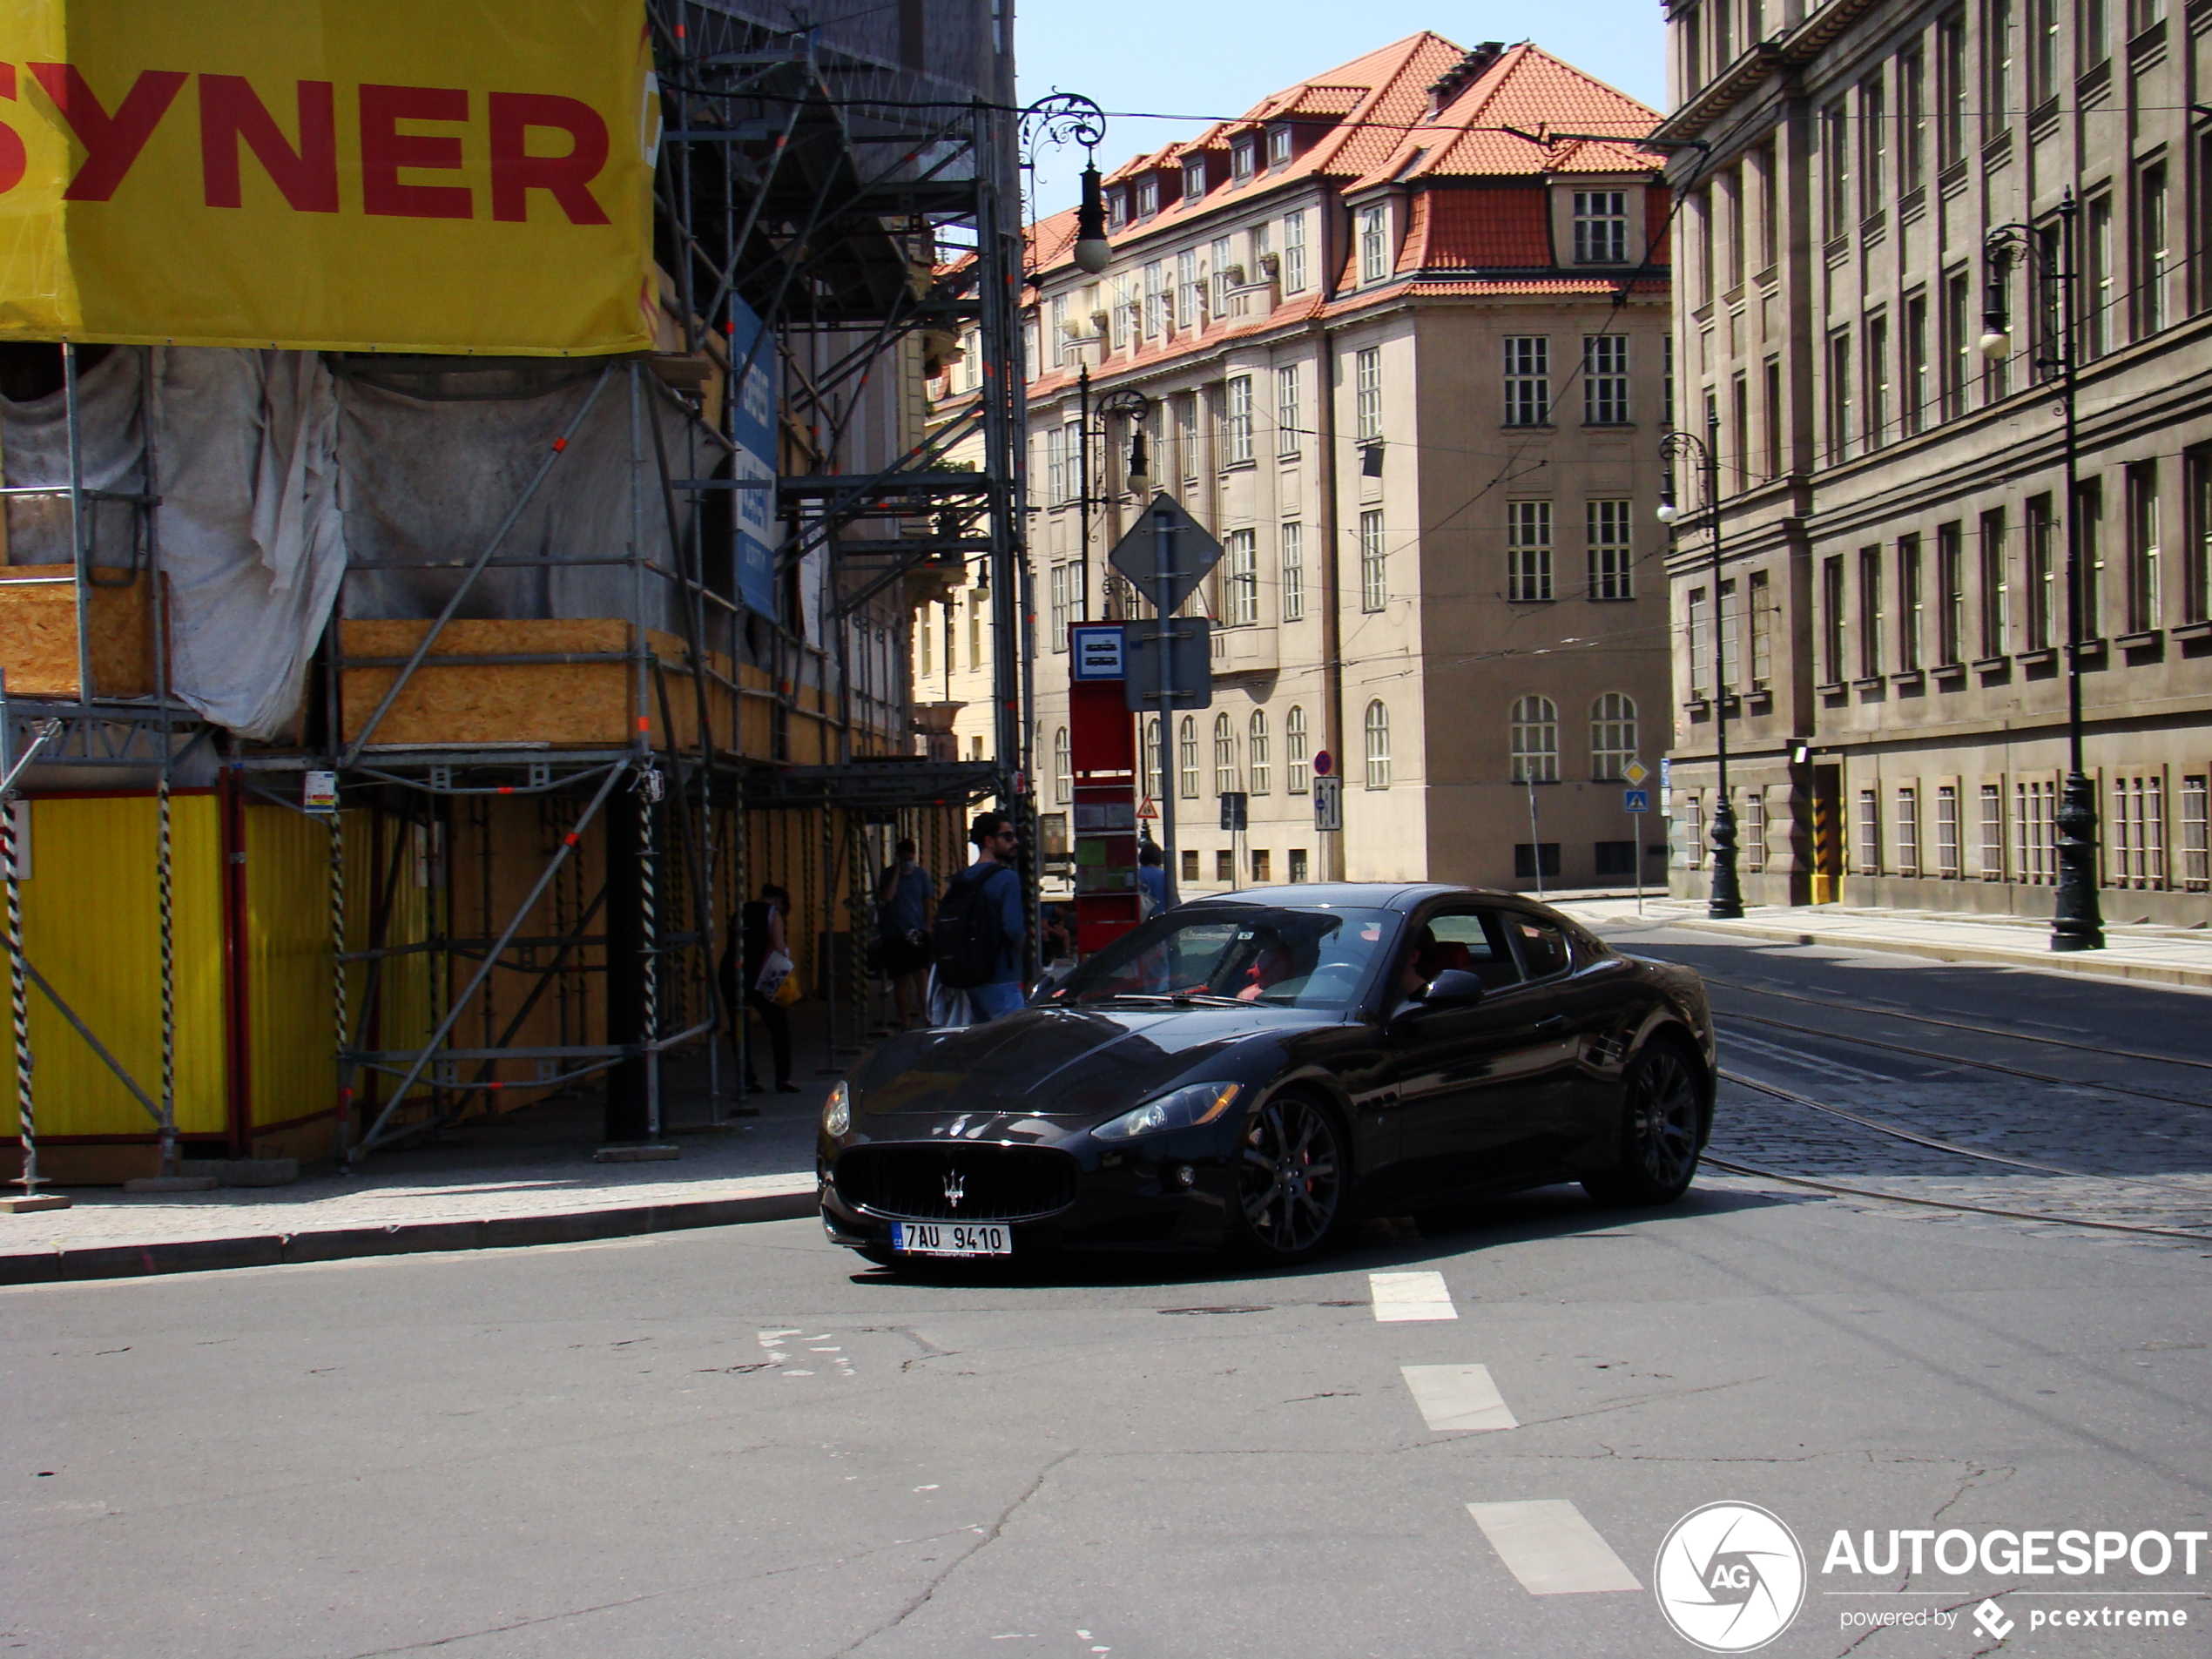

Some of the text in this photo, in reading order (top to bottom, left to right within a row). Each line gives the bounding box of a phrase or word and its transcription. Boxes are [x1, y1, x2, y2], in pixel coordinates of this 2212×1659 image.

[0, 61, 613, 226] YNER
[905, 1224, 940, 1248] 7AU
[954, 1226, 1001, 1250] 9410
